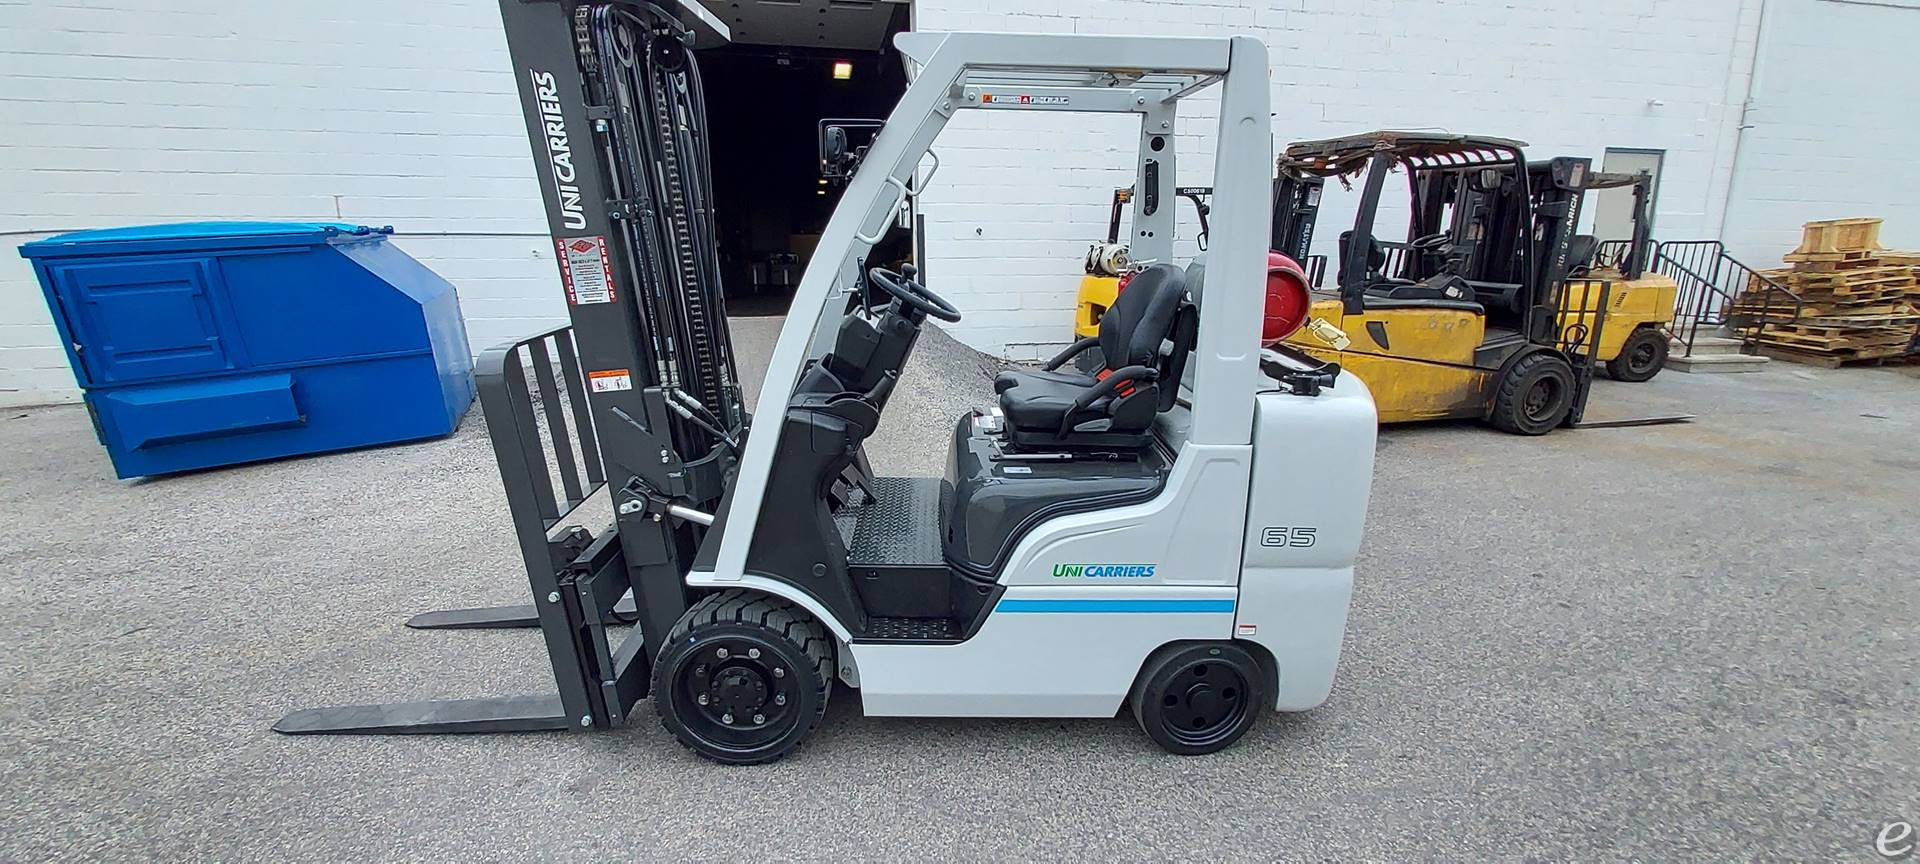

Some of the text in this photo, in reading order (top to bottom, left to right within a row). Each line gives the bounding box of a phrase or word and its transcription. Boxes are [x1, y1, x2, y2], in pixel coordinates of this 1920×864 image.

[558, 241, 577, 302] SERVICE
[598, 238, 615, 299] RENTALS
[1260, 526, 1317, 548] 65
